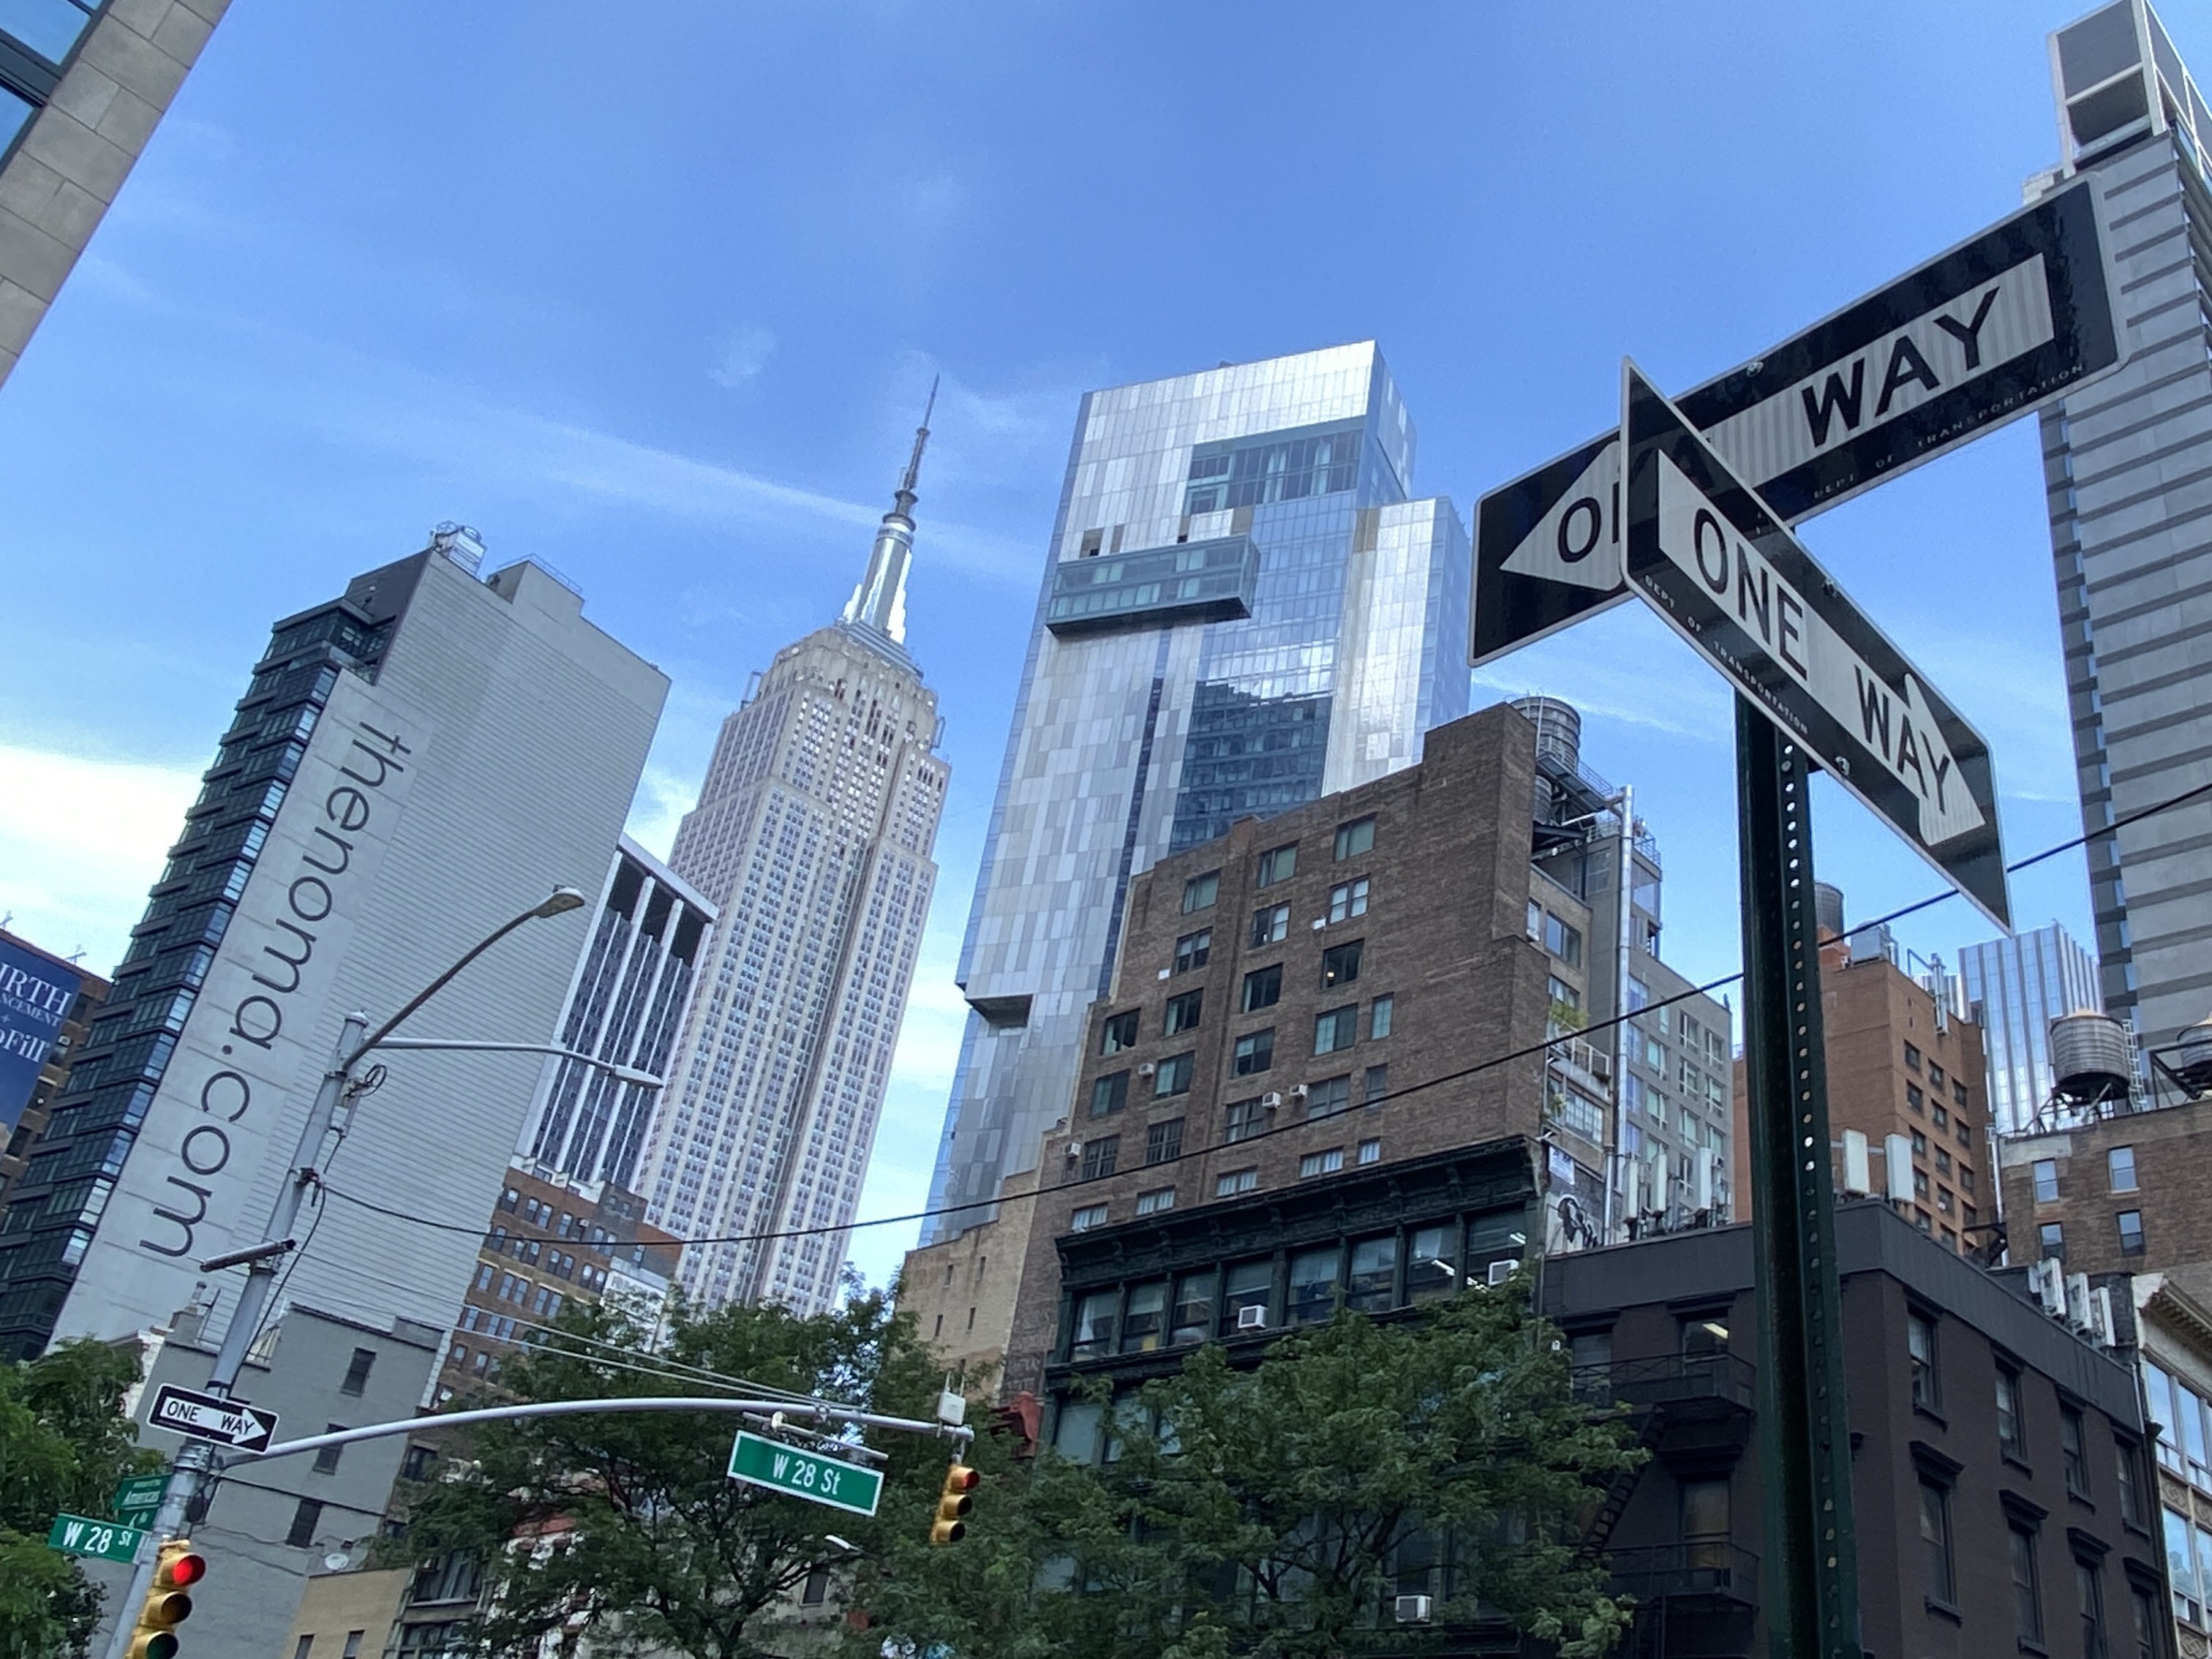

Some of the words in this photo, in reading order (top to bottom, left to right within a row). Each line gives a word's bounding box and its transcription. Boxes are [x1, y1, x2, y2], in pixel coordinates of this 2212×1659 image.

[1801, 286, 2001, 448] WAY
[1917, 363, 2084, 448] TRANSPORTATION
[1645, 575, 1675, 609] DEPT
[1687, 615, 1702, 633] OF
[1712, 640, 1808, 734] TRANSPORTATION
[1694, 508, 1808, 682] ONE
[1854, 663, 1951, 816] WAY
[140, 721, 412, 1257] thenoma.com
[167, 1400, 201, 1423] ONE
[220, 1414, 255, 1435] WAY
[773, 1452, 790, 1479] W
[791, 1459, 817, 1488] 28
[820, 1468, 841, 1495] St
[63, 1521, 85, 1549] W
[84, 1526, 113, 1554] 28
[118, 1530, 133, 1547] St
